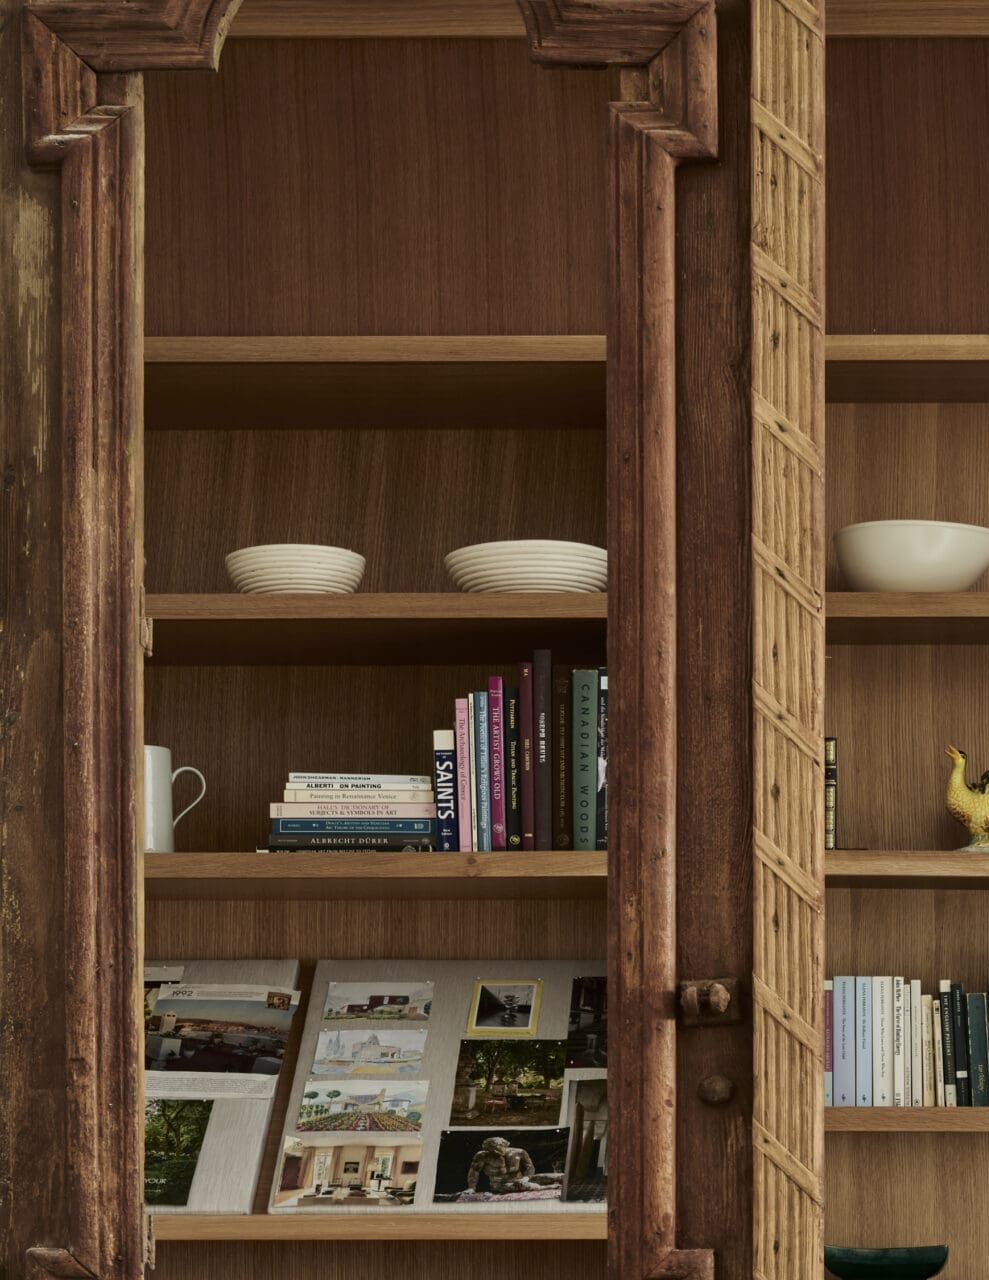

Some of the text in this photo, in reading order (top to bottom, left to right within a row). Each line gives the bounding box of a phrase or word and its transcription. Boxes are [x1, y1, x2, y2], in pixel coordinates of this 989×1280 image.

[458, 731, 467, 770] Archaeology
[492, 707, 501, 800] THE ARTIST GROWS OLD
[580, 683, 591, 845] CANADIAN WOODS
[436, 760, 455, 820] SAINTS
[460, 771, 467, 779] of
[460, 779, 468, 801] Greece
[359, 836, 389, 844] DÜRER
[172, 990, 194, 998] 1992
